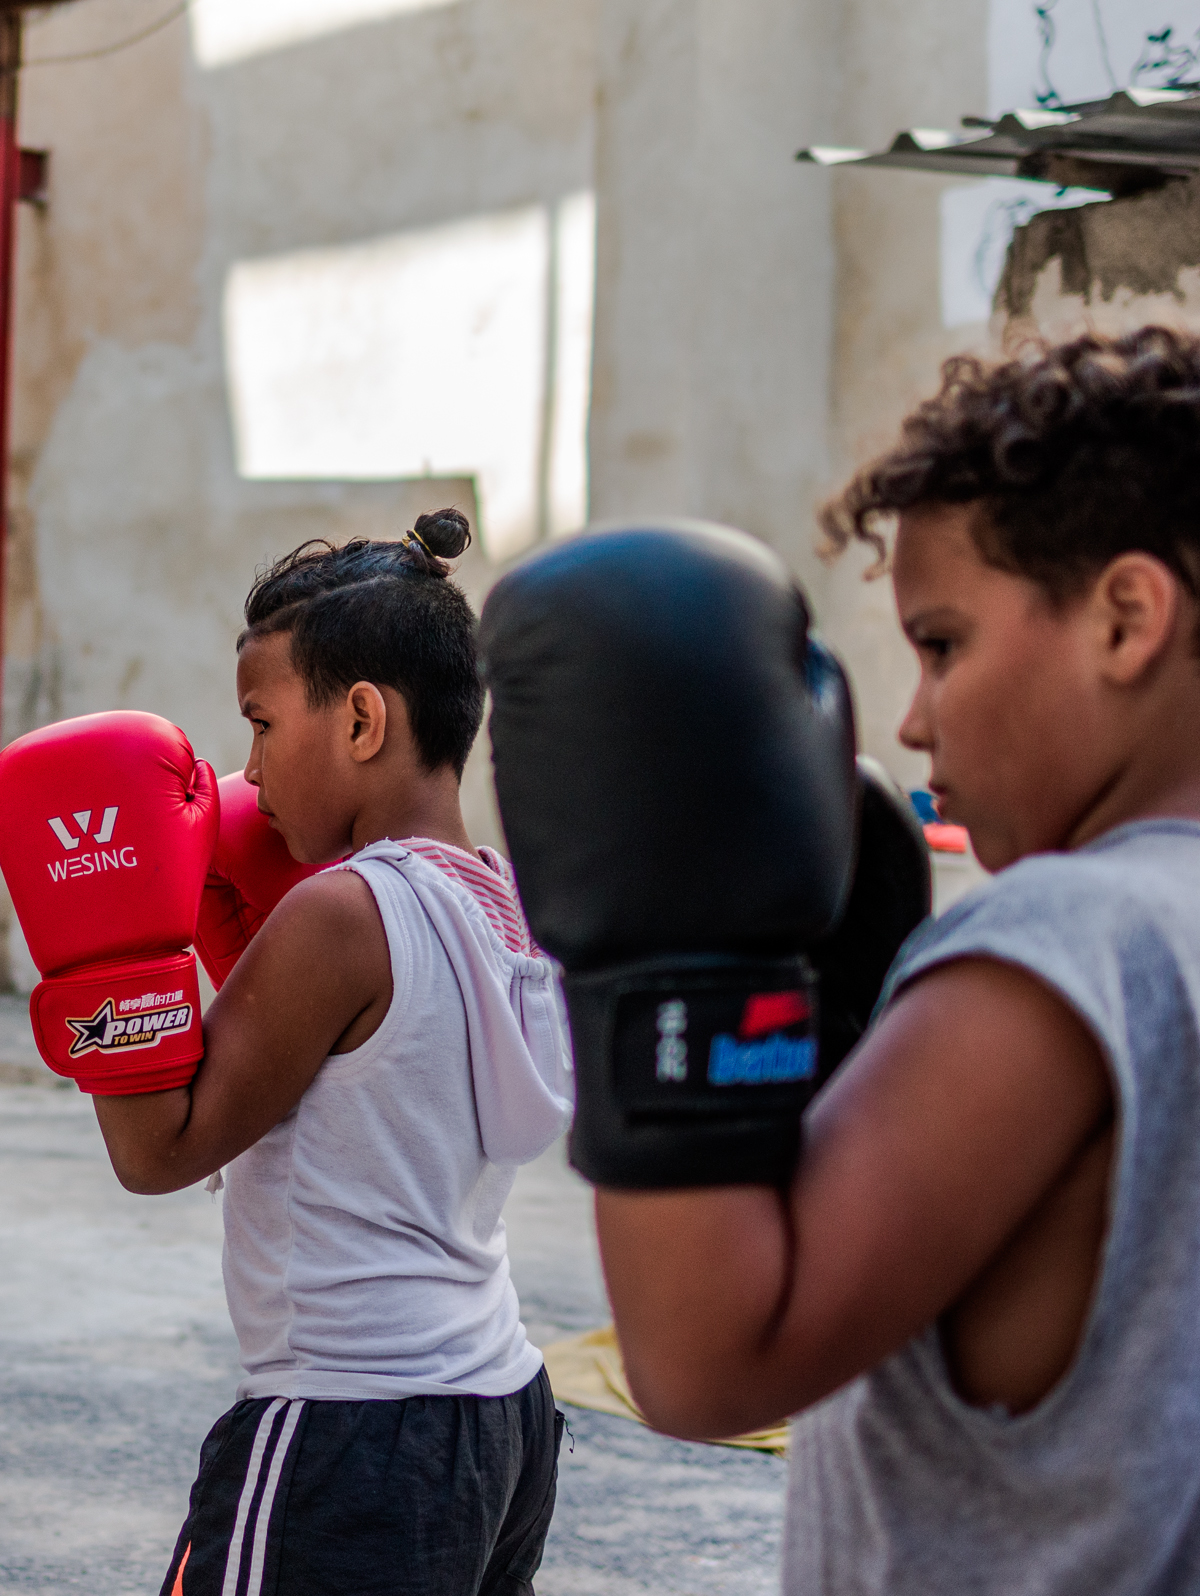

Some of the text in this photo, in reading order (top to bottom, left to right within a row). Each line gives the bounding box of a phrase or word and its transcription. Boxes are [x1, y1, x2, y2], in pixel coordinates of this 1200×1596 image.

[46, 846, 138, 883] WESING
[102, 1007, 189, 1046] POWER
[113, 1031, 154, 1046] TO WIN
